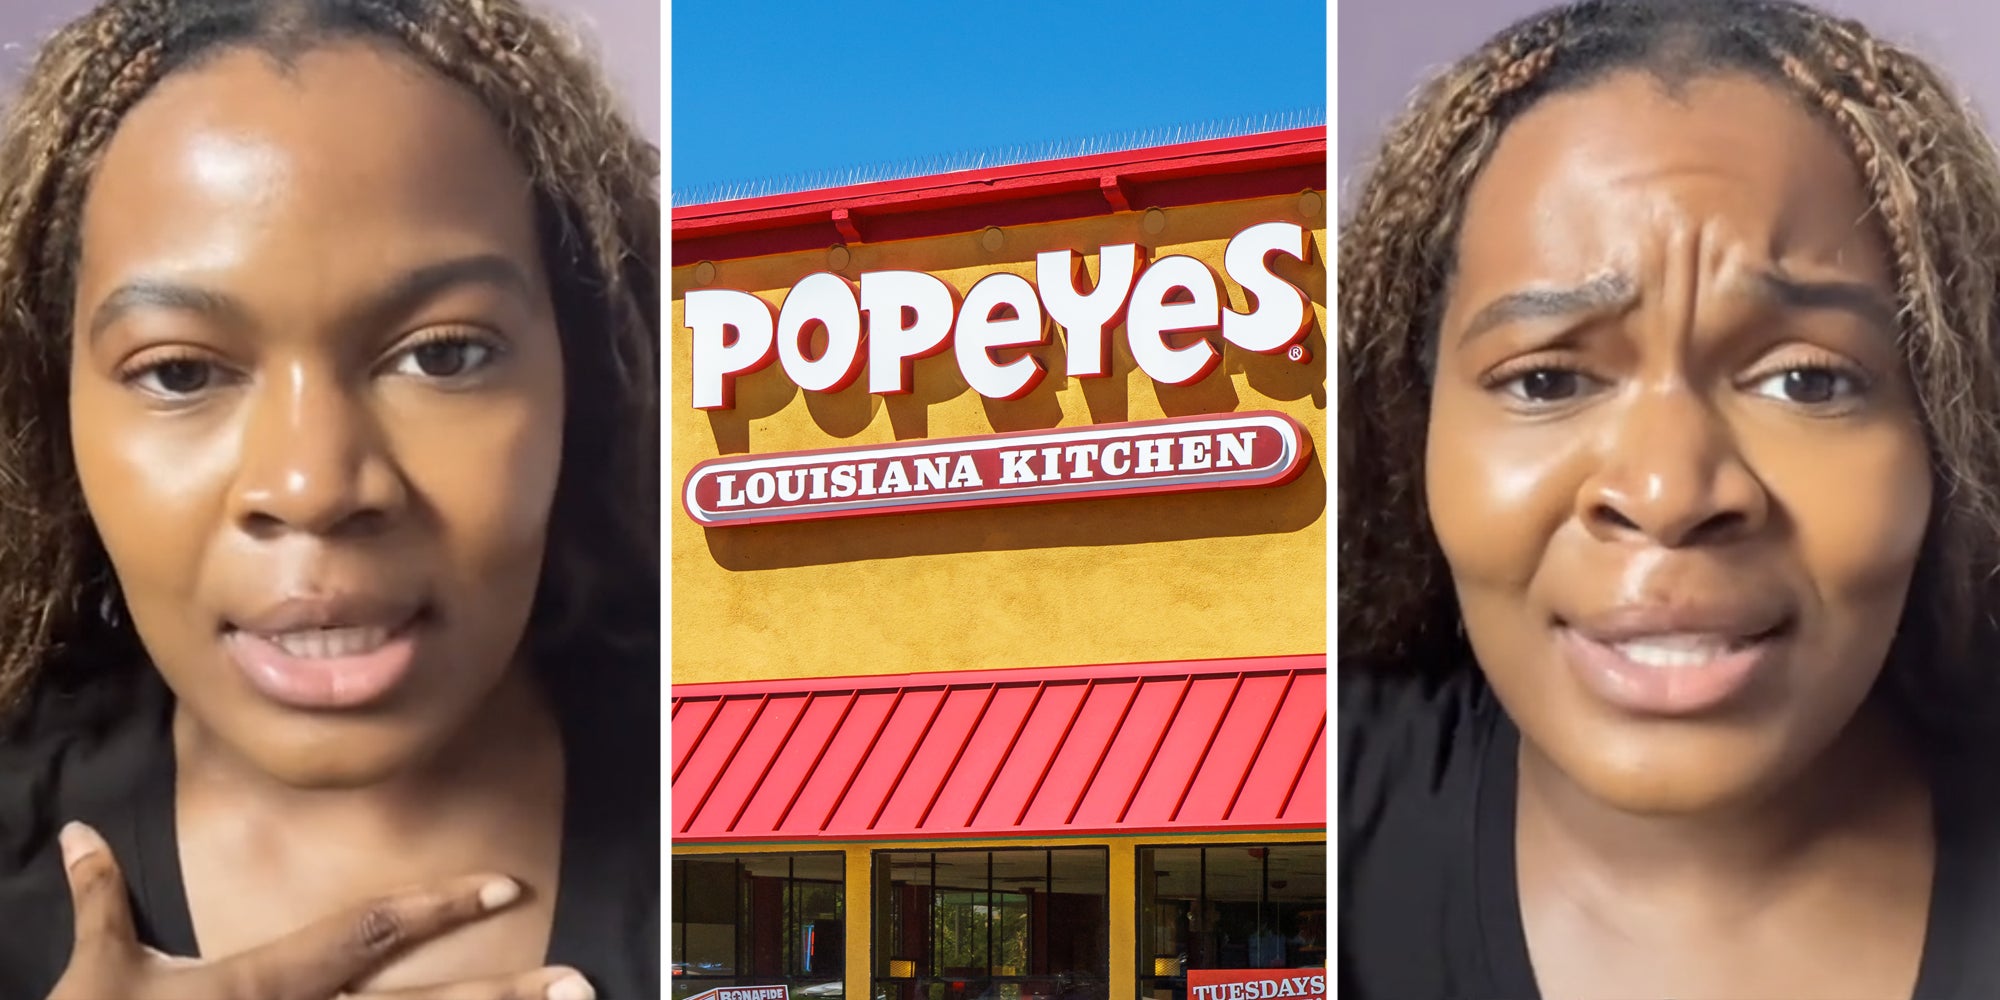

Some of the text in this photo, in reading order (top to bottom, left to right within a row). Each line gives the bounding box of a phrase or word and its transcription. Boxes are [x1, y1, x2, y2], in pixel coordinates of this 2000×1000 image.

[716, 432, 1257, 508] LOUISIANA KITCHEN
[720, 988, 784, 1000] BONAFIDE
[1193, 976, 1325, 1000] TUESDAYS
